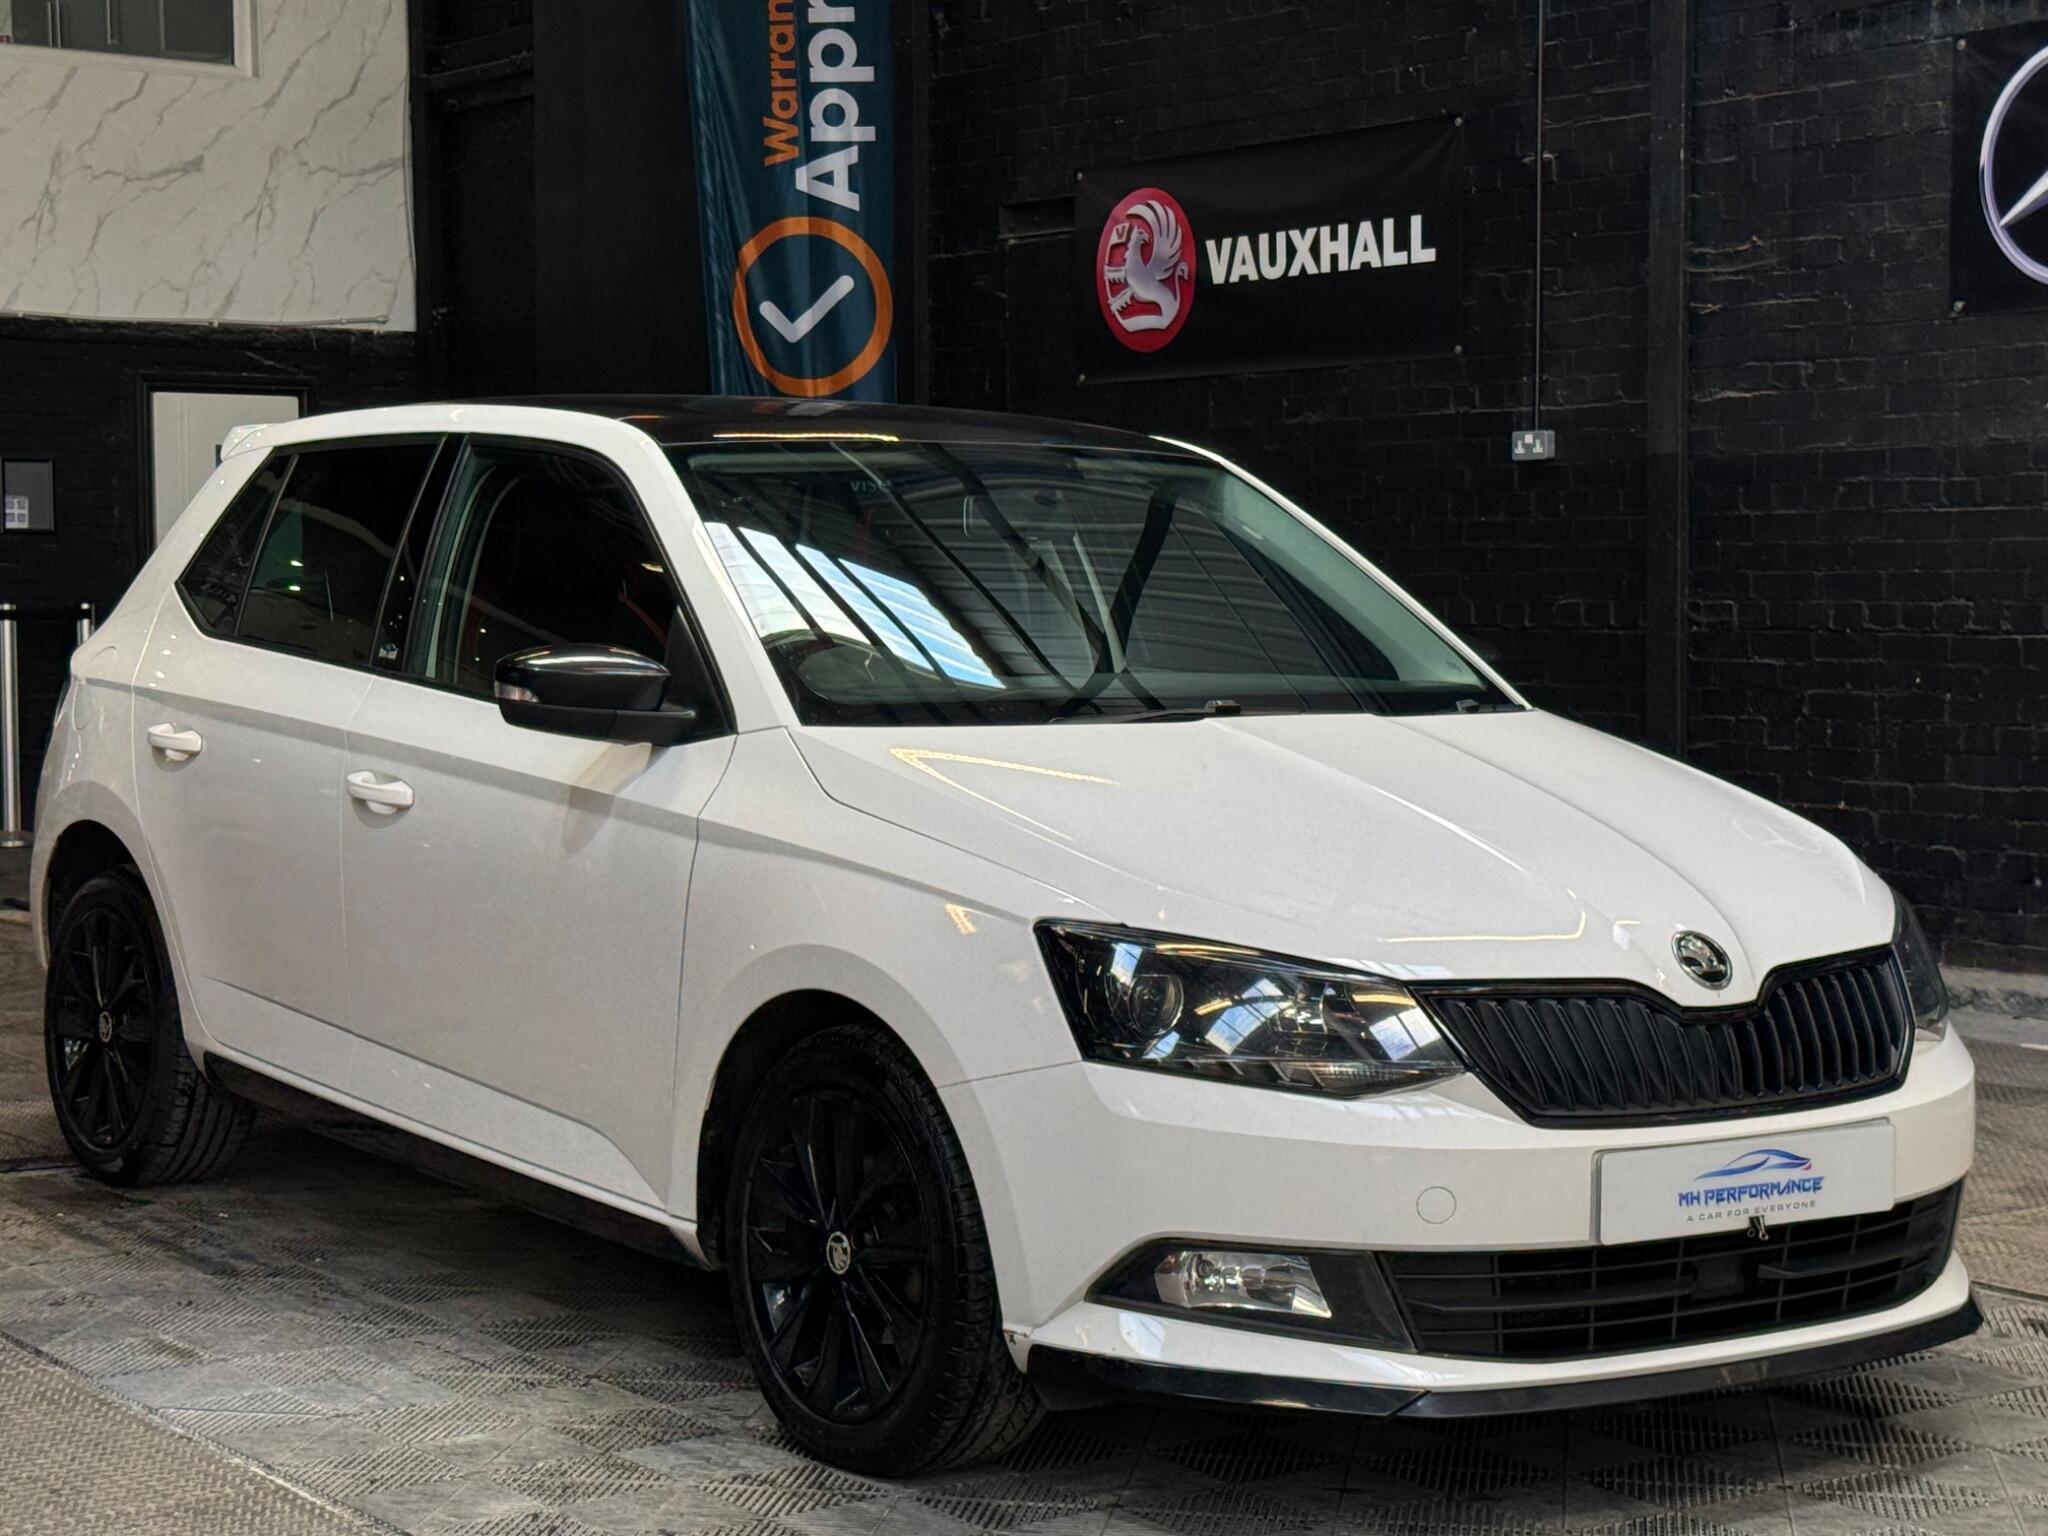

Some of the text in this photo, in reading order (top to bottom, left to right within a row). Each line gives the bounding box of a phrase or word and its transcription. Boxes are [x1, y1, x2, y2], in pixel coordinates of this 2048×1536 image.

[1205, 214, 1436, 285] VAUXHALL
[1677, 1176, 1825, 1207] MH PERFORMANCE
[1698, 1211, 1722, 1221] CAR
[1727, 1208, 1749, 1217] FOR
[1754, 1199, 1817, 1214] EVERYONE
